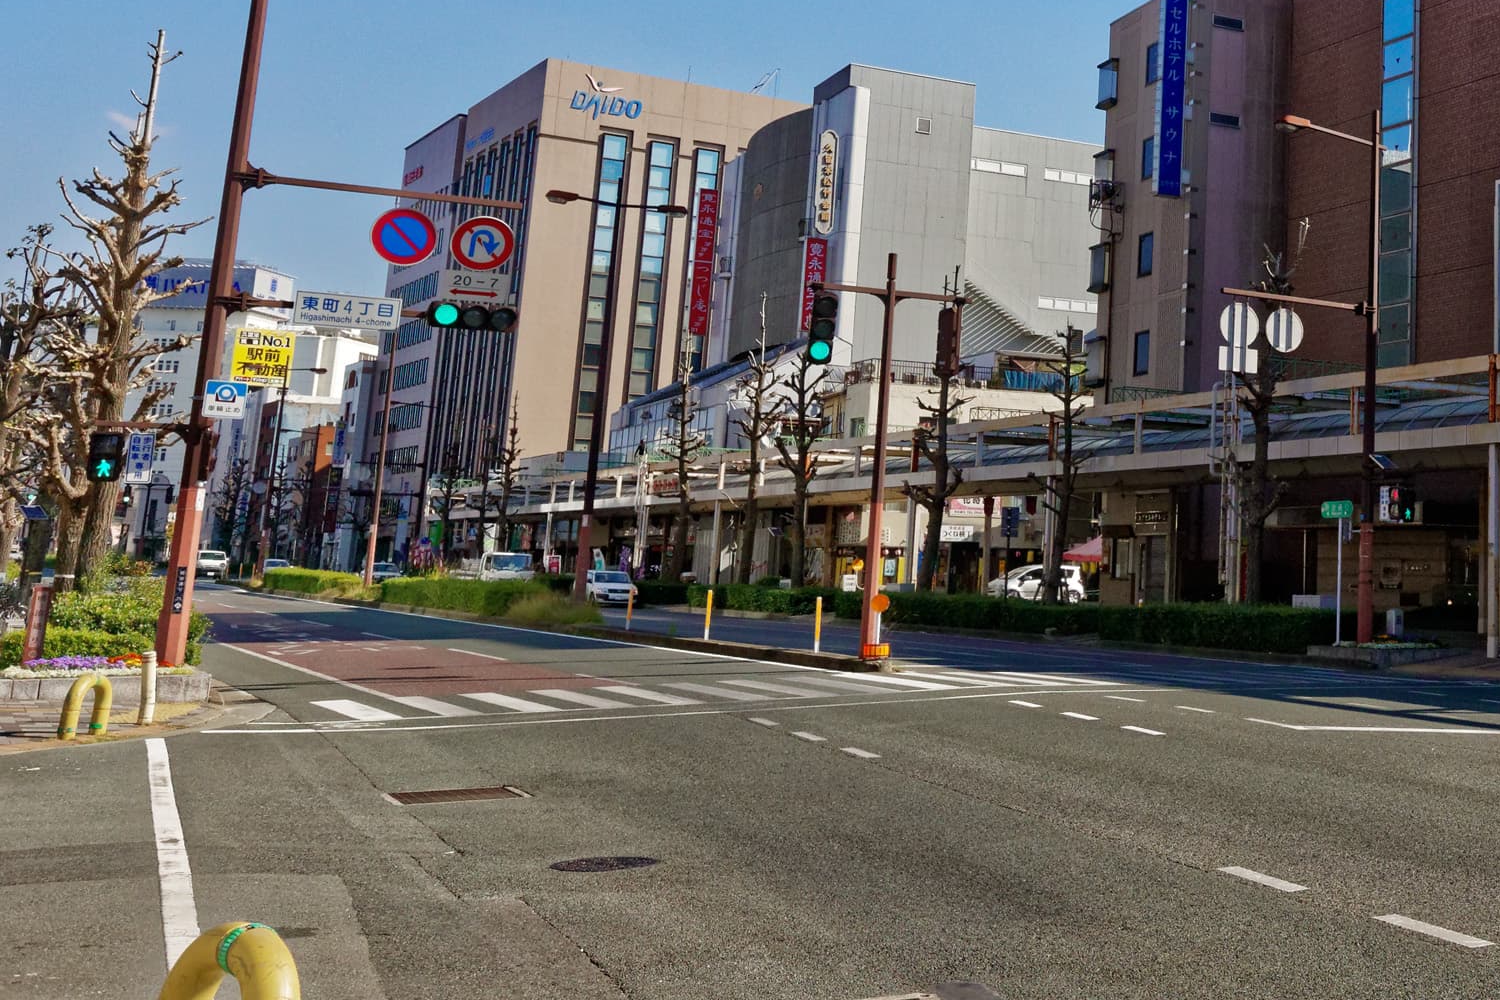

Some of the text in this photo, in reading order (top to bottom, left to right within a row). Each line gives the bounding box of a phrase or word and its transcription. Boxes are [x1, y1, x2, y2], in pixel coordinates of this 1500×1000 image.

[570, 90, 643, 121] DAIDO
[302, 296, 394, 318] 東町4丁目
[300, 311, 392, 327] Higashimachi 4-chome
[247, 347, 281, 363] 駅前
[237, 361, 287, 377] 不動産
